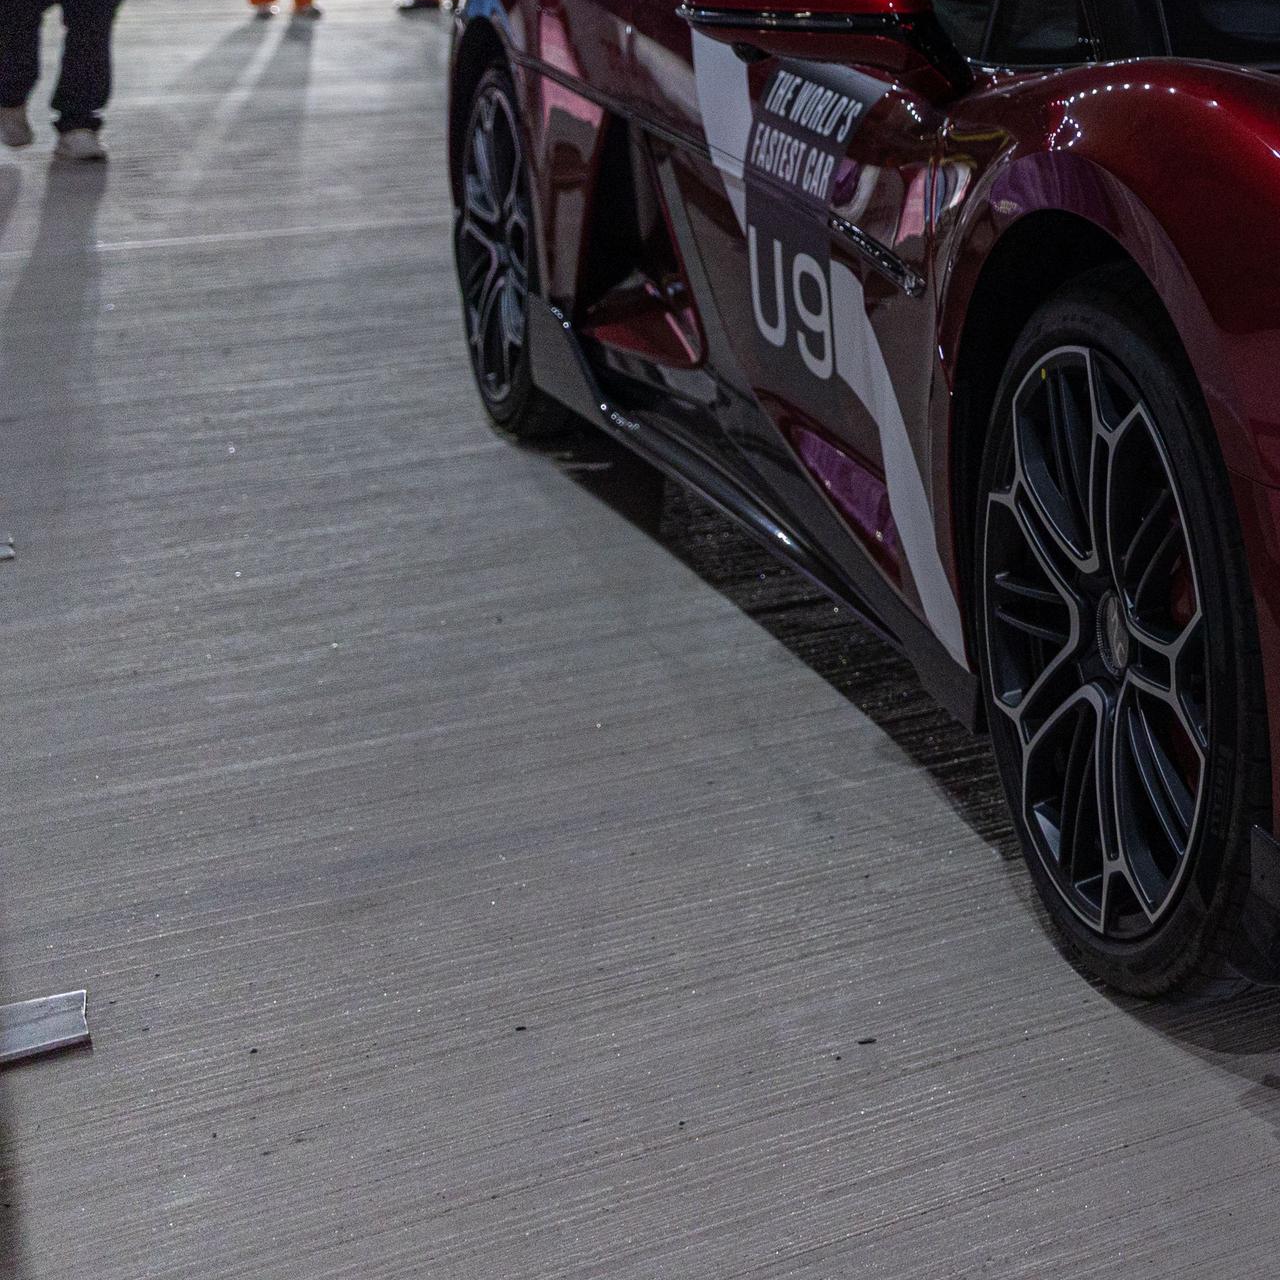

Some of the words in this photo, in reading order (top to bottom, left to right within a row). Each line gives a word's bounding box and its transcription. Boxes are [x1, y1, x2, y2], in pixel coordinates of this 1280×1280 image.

[764, 70, 801, 120] THE
[799, 78, 863, 143] WORLD'S
[751, 122, 802, 186] FASTEST
[801, 146, 836, 200] CAR
[748, 224, 834, 380] U9
